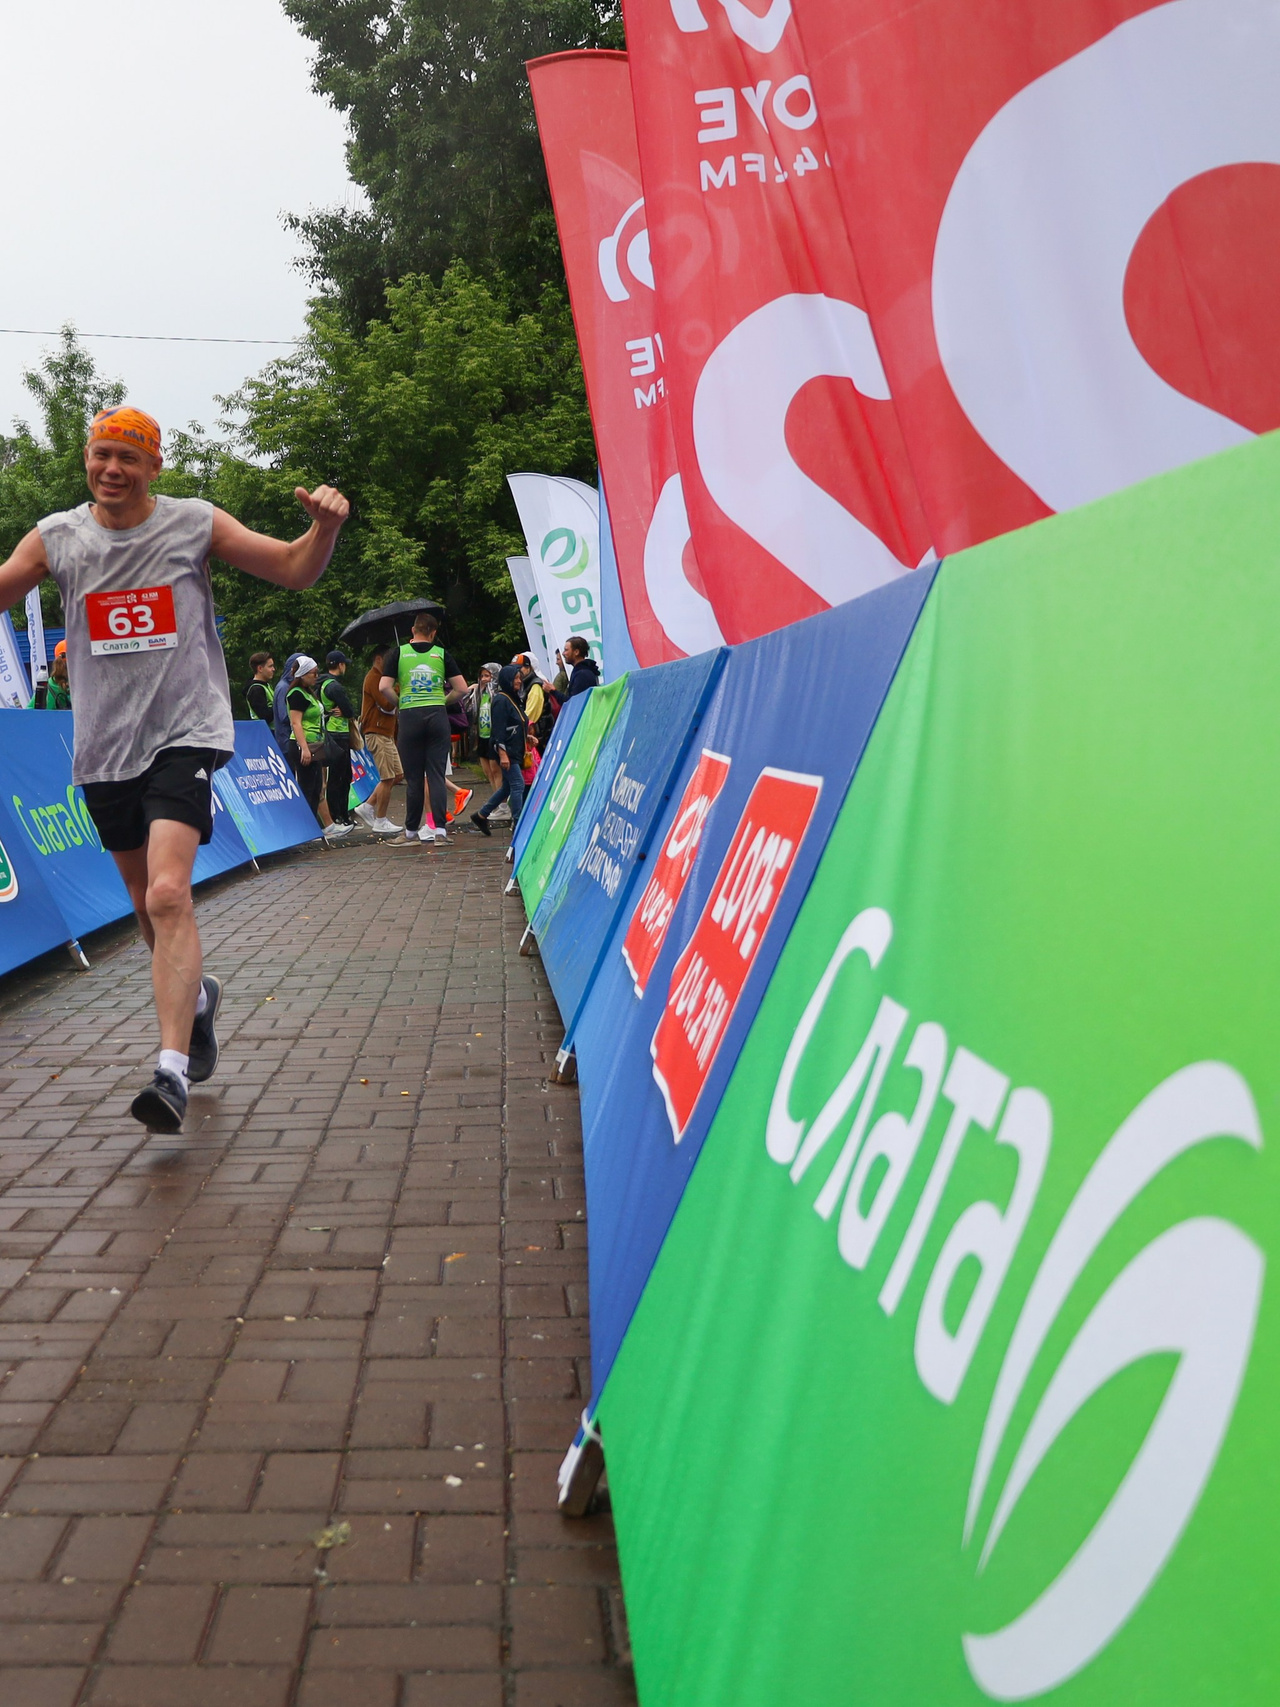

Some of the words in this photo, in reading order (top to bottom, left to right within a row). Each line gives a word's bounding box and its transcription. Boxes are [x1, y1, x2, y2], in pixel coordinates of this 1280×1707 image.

[103, 642, 129, 651] Слата
[108, 604, 155, 636] 63
[12, 795, 84, 856] Слата
[710, 819, 793, 960] LOVE
[668, 950, 729, 1071] 104.2FM
[765, 906, 1053, 1405] Слата
